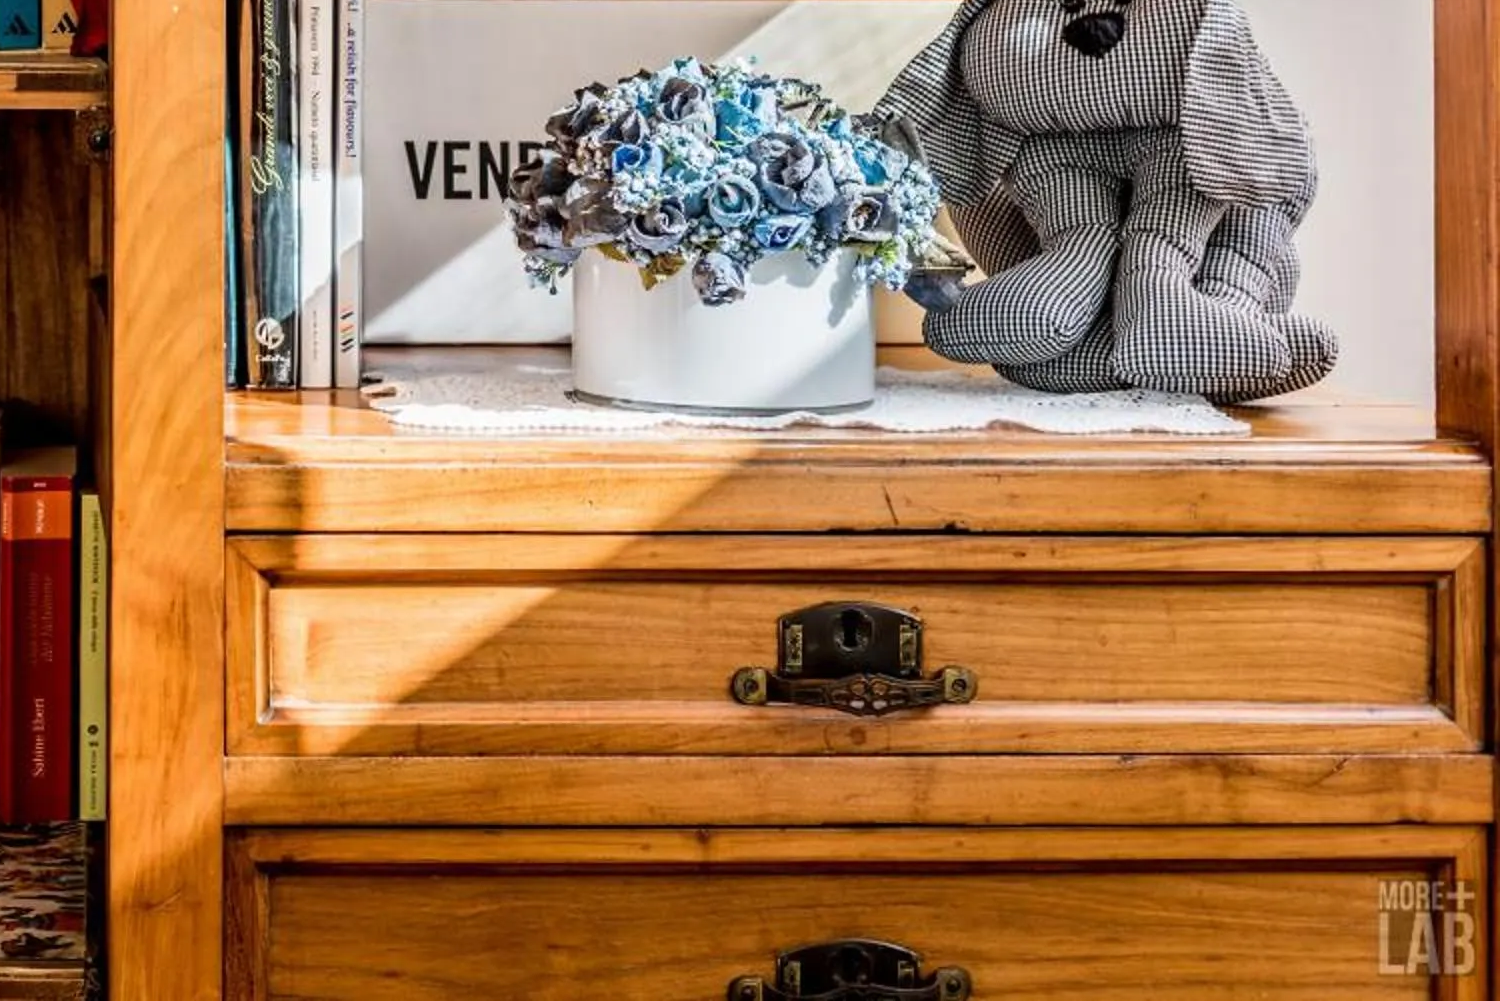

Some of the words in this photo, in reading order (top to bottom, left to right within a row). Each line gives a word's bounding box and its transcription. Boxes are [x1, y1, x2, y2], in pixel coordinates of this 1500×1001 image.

[346, 39, 358, 76] relish
[343, 77, 358, 96] for
[250, 110, 283, 195] Grandi
[32, 697, 45, 732] Ebert
[32, 734, 45, 778] Sabine
